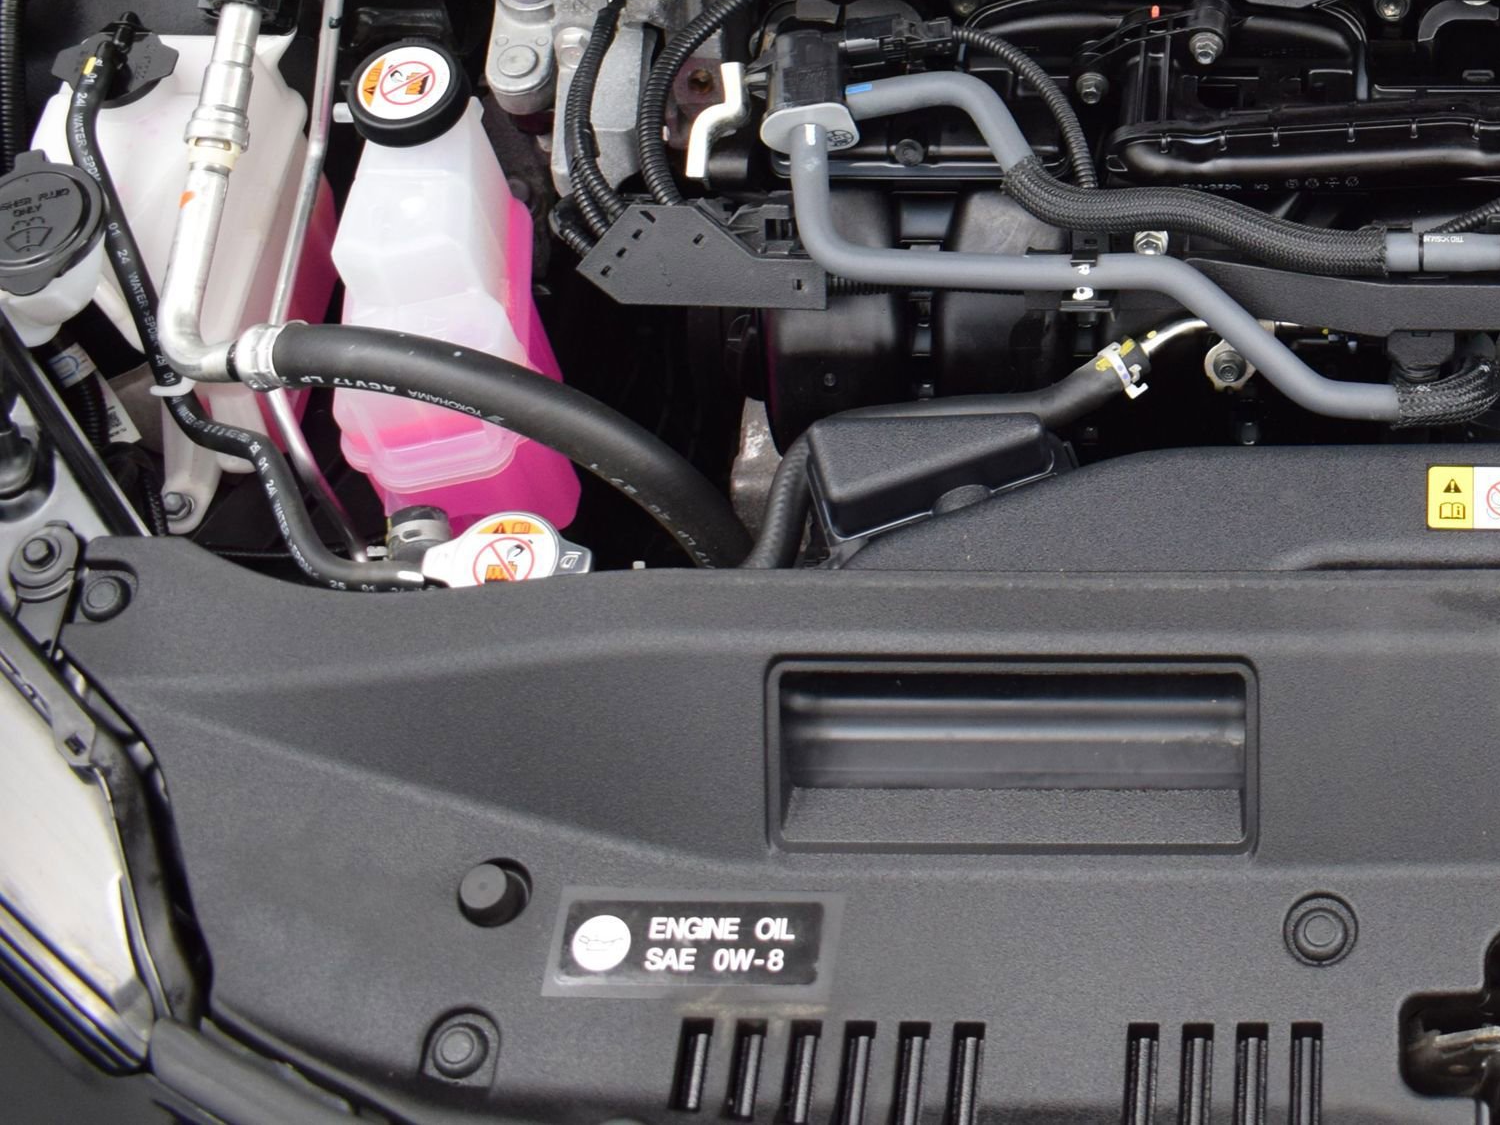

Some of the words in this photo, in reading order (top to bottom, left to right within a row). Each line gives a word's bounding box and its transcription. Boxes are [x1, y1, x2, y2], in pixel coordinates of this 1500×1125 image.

[72, 113, 87, 147] WATER
[0, 197, 32, 211] SHER
[13, 203, 42, 218] ONLY
[108, 222, 121, 236] 01
[116, 249, 131, 264] 24
[128, 271, 149, 309] WATER
[333, 377, 396, 393] ACV17
[408, 388, 483, 418] YOKOHAMA
[648, 917, 741, 940] ENGINE
[754, 917, 796, 940] OIL
[643, 948, 697, 972] SAE
[712, 948, 785, 972] 0W-8
